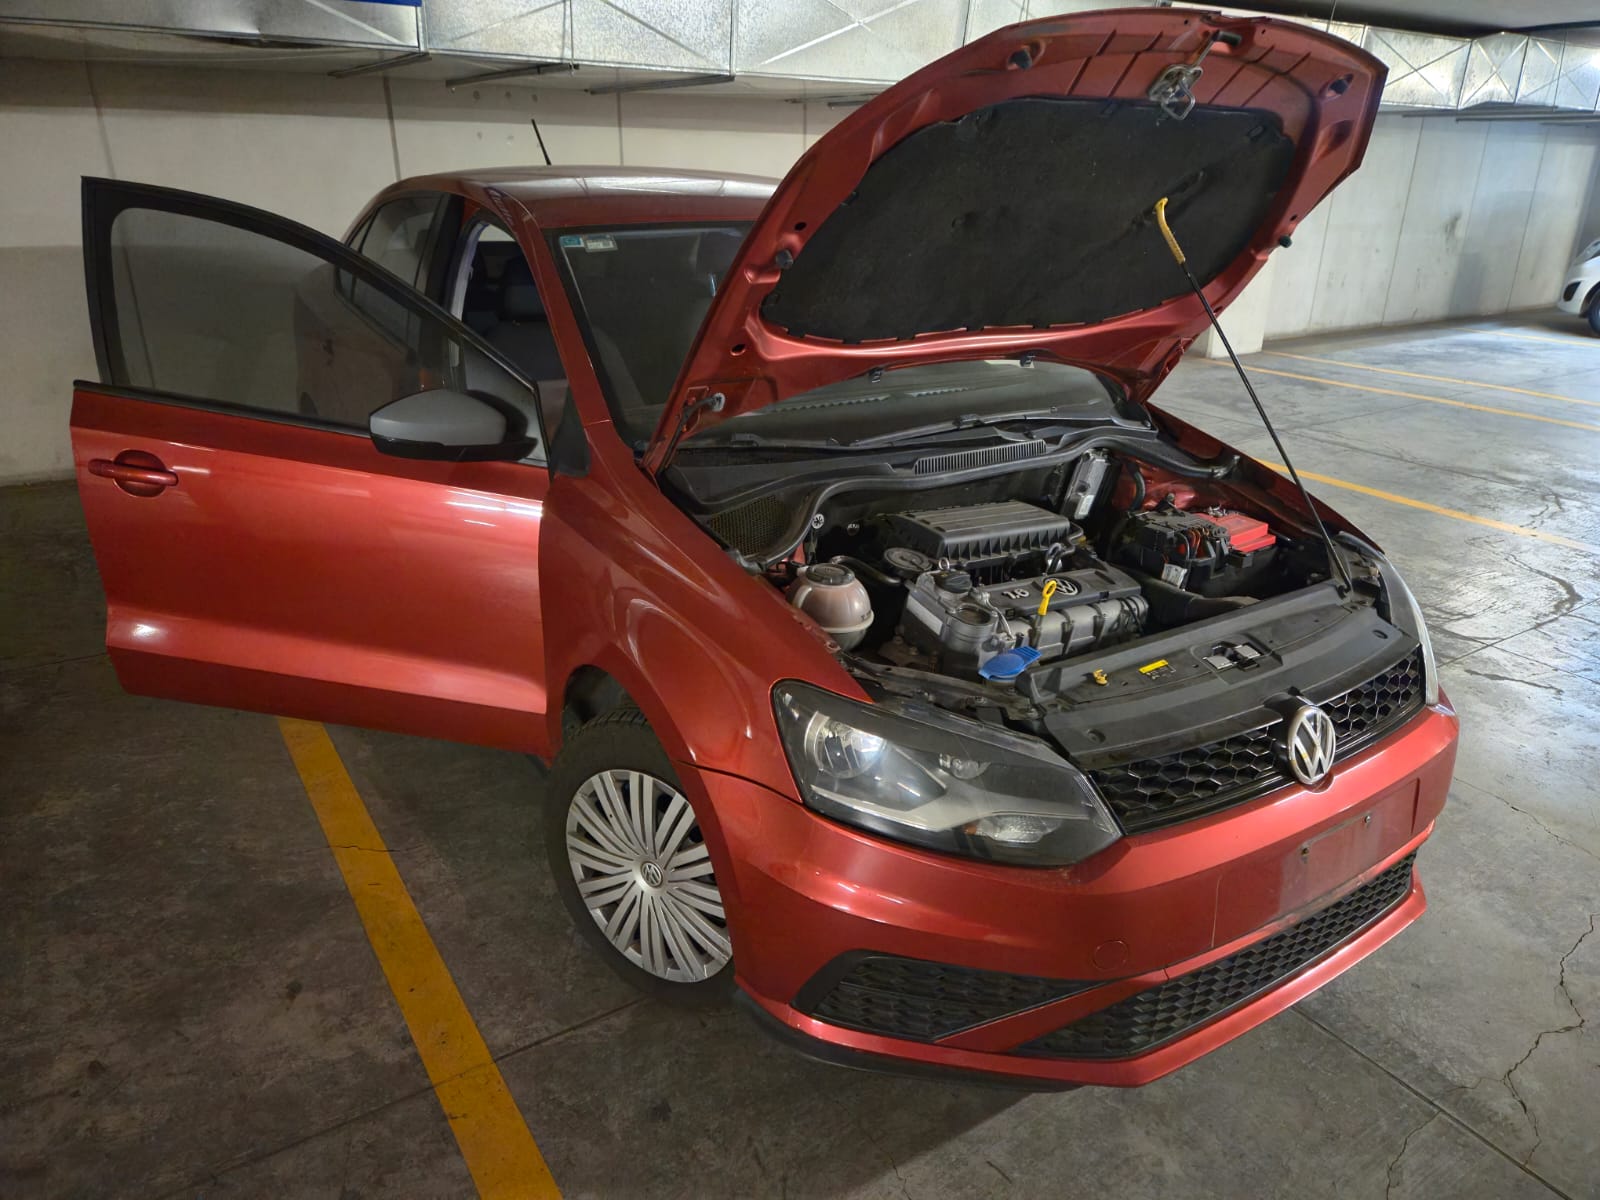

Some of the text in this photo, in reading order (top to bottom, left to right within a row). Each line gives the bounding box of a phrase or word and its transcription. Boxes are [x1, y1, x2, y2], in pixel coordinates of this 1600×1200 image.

[1001, 588, 1030, 600] 1.6
[1288, 705, 1336, 785] VW
[641, 861, 663, 888] VW
